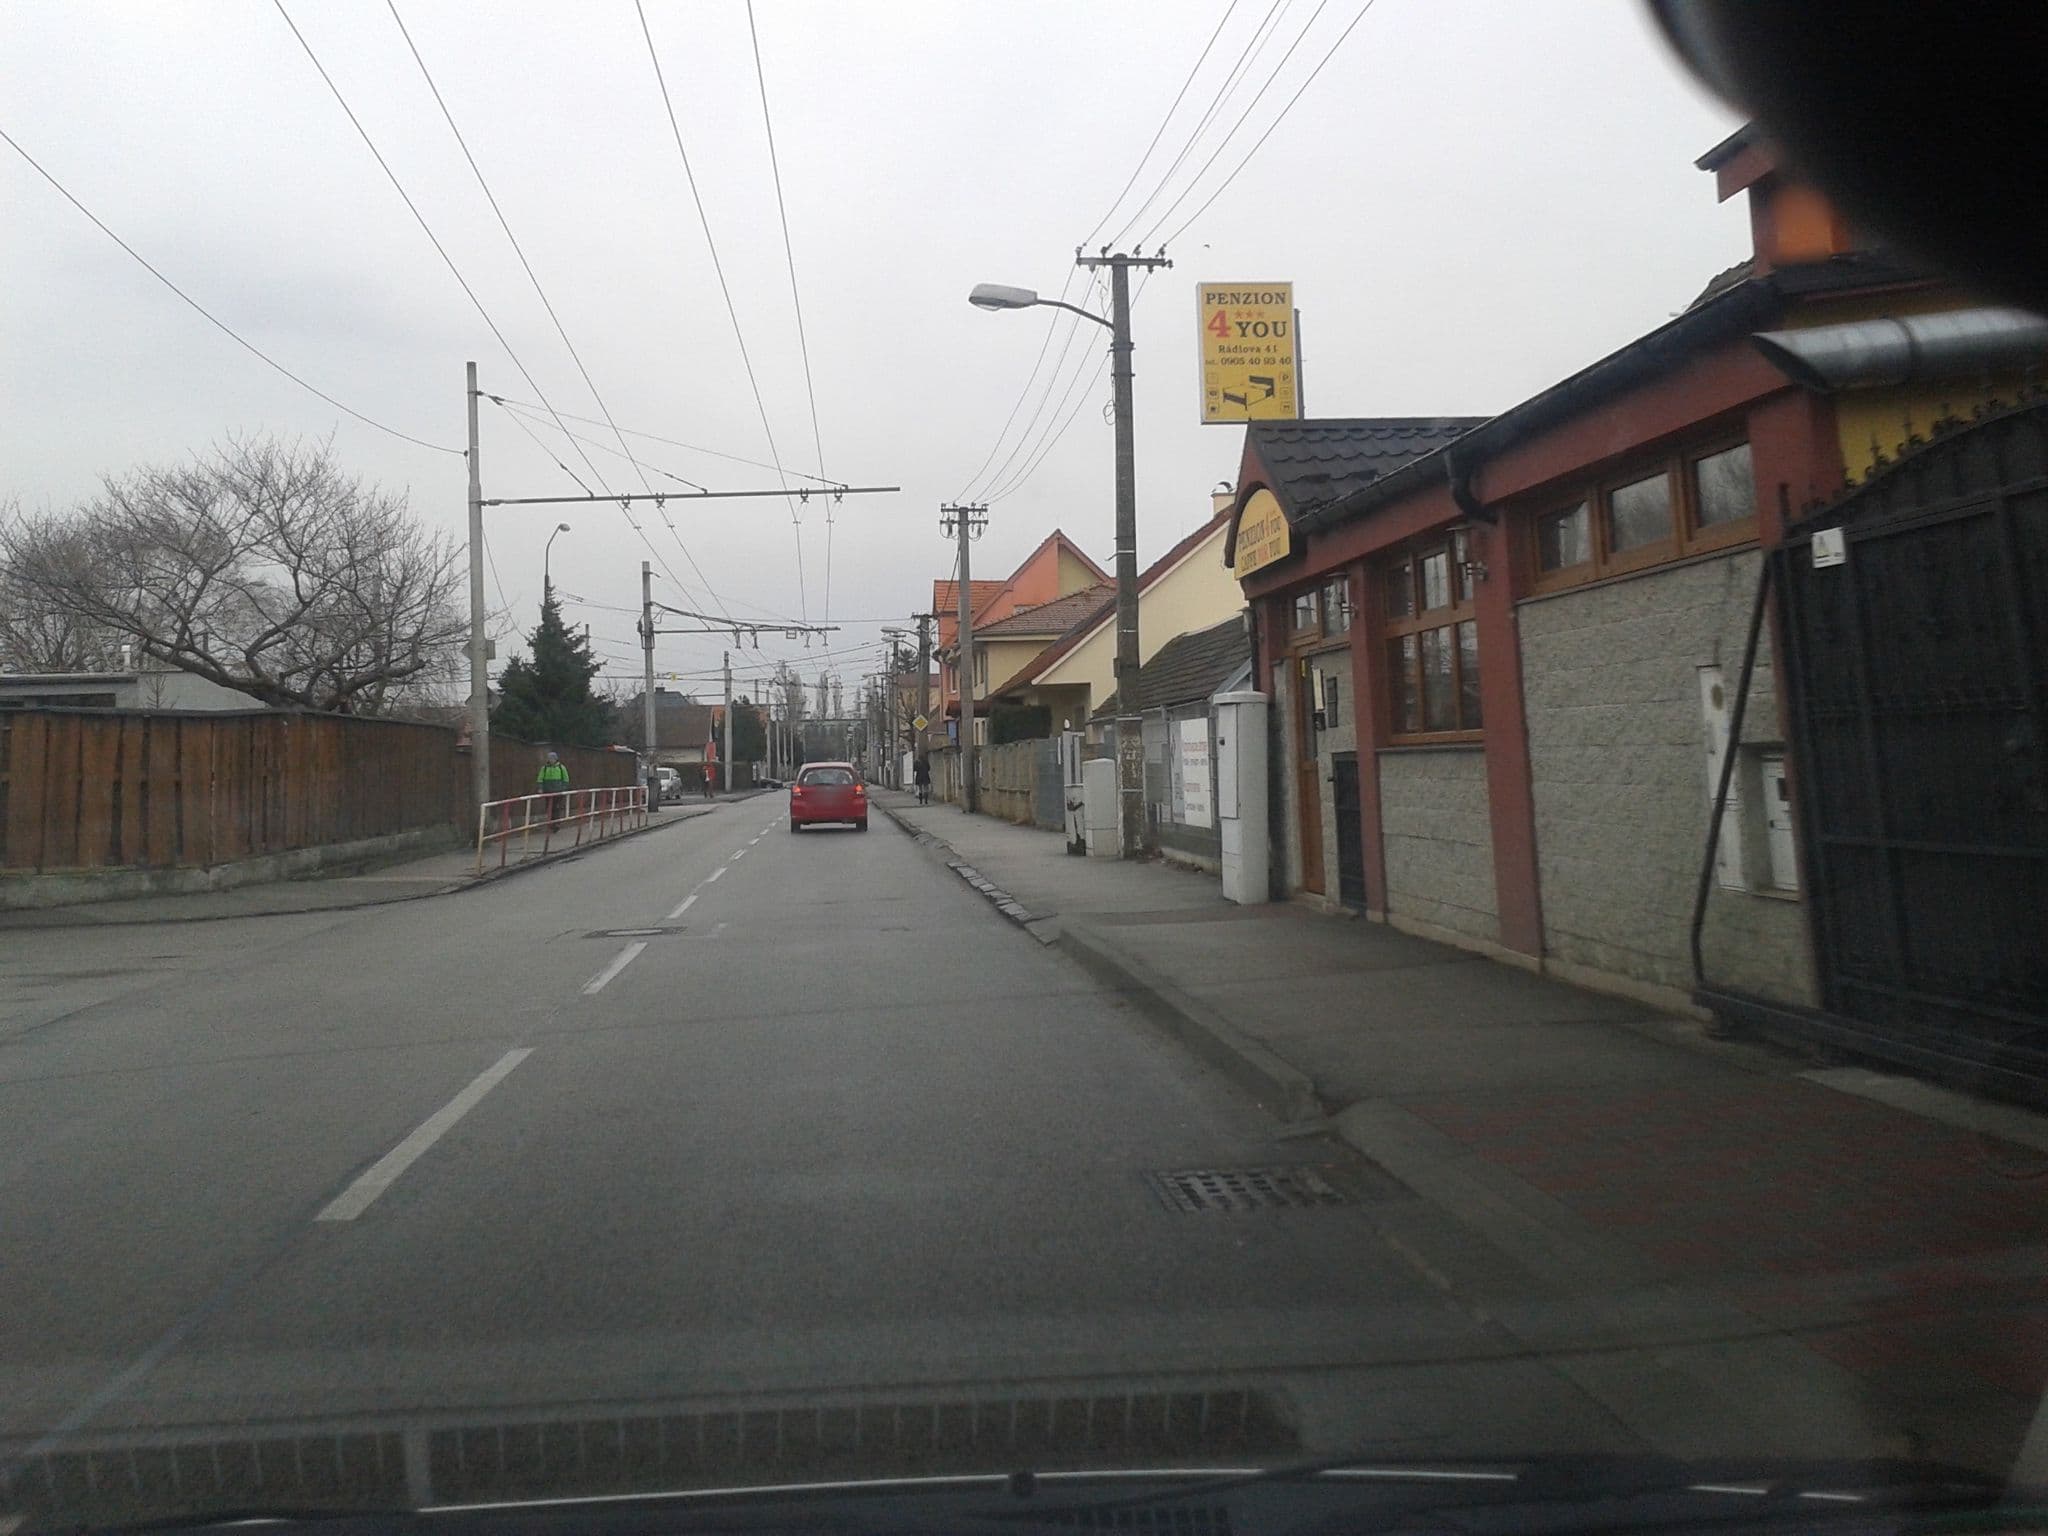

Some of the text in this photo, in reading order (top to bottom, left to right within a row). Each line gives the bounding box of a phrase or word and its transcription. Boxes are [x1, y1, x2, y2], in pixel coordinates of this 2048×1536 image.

[1206, 293, 1286, 304] PENZION
[1207, 310, 1287, 338] 4 YOU
[1265, 345, 1277, 353] 41
[1248, 357, 1261, 366] 40
[1279, 356, 1292, 366] 40
